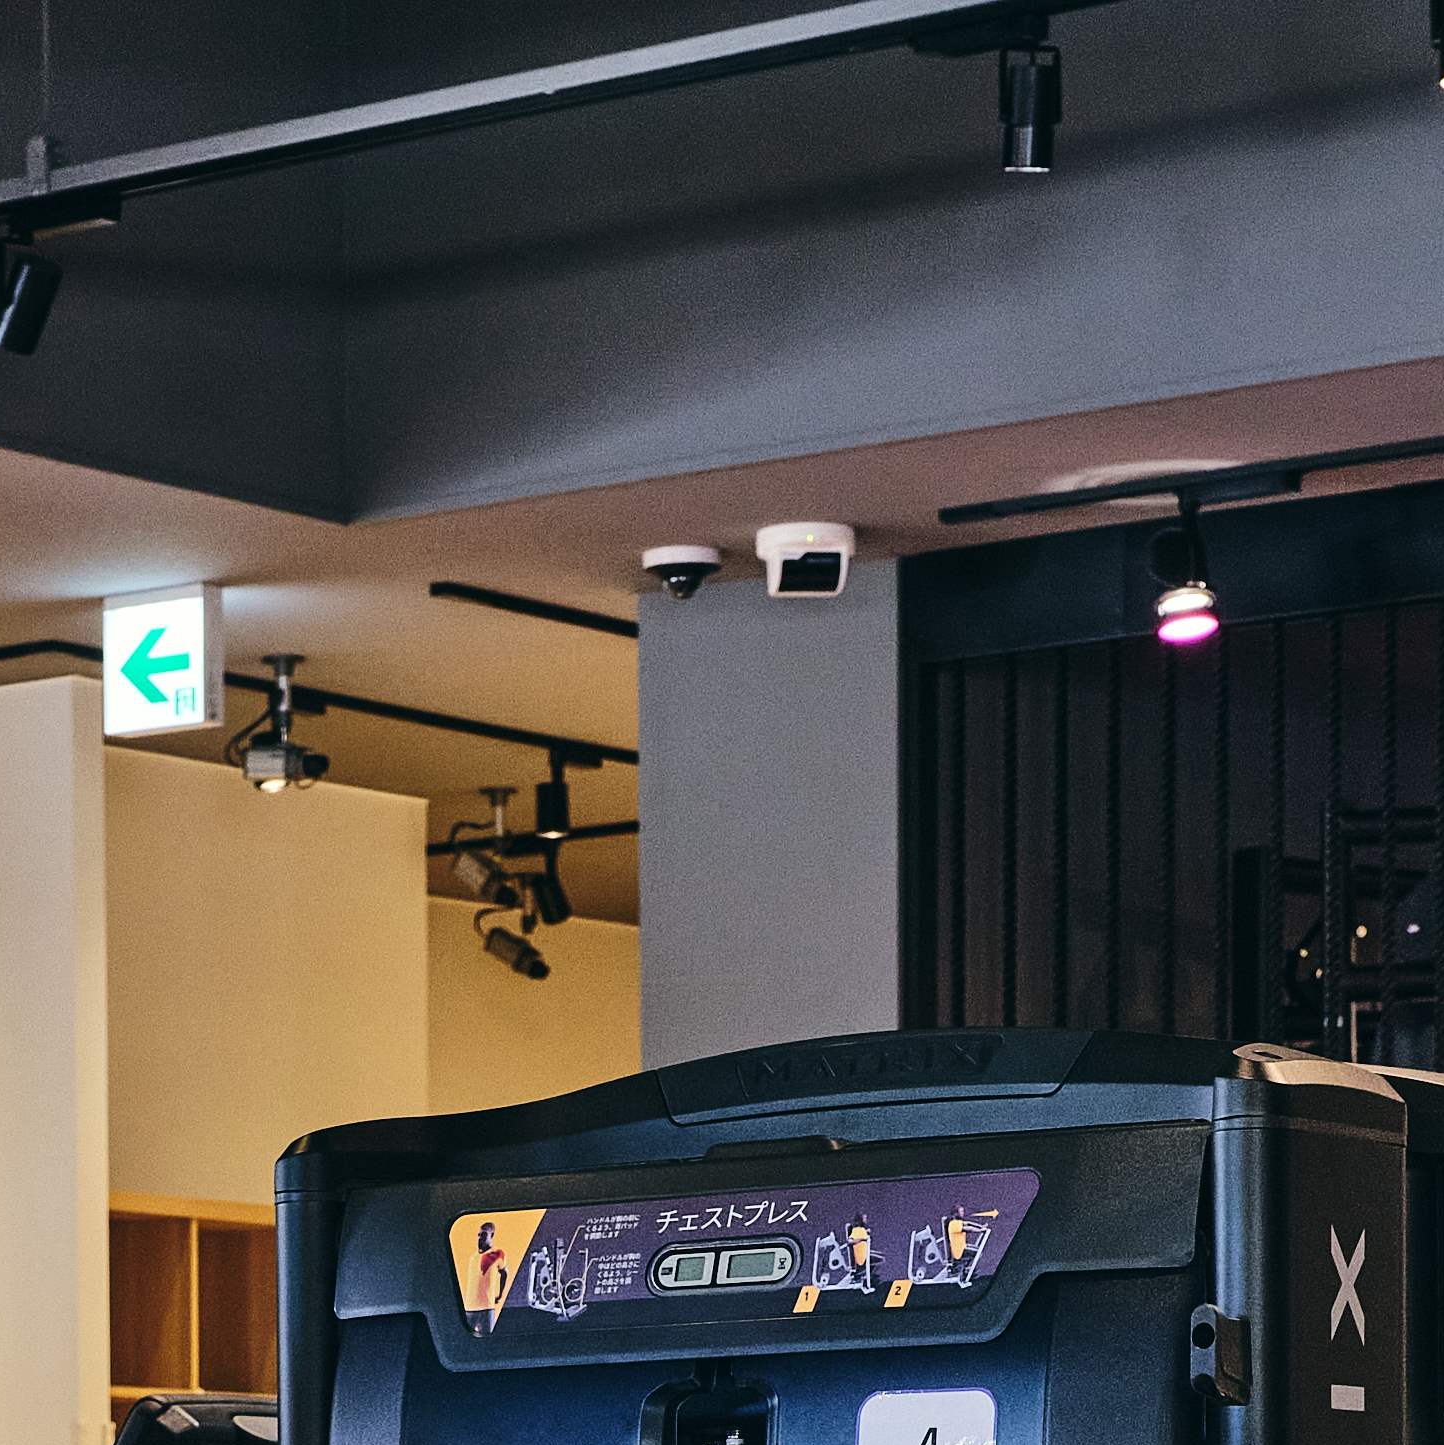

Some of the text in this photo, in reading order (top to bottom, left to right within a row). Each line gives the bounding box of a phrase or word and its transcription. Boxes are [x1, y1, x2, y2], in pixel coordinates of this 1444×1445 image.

[656, 1200, 809, 1234] チェストプレス
[894, 1286, 902, 1295] 2
